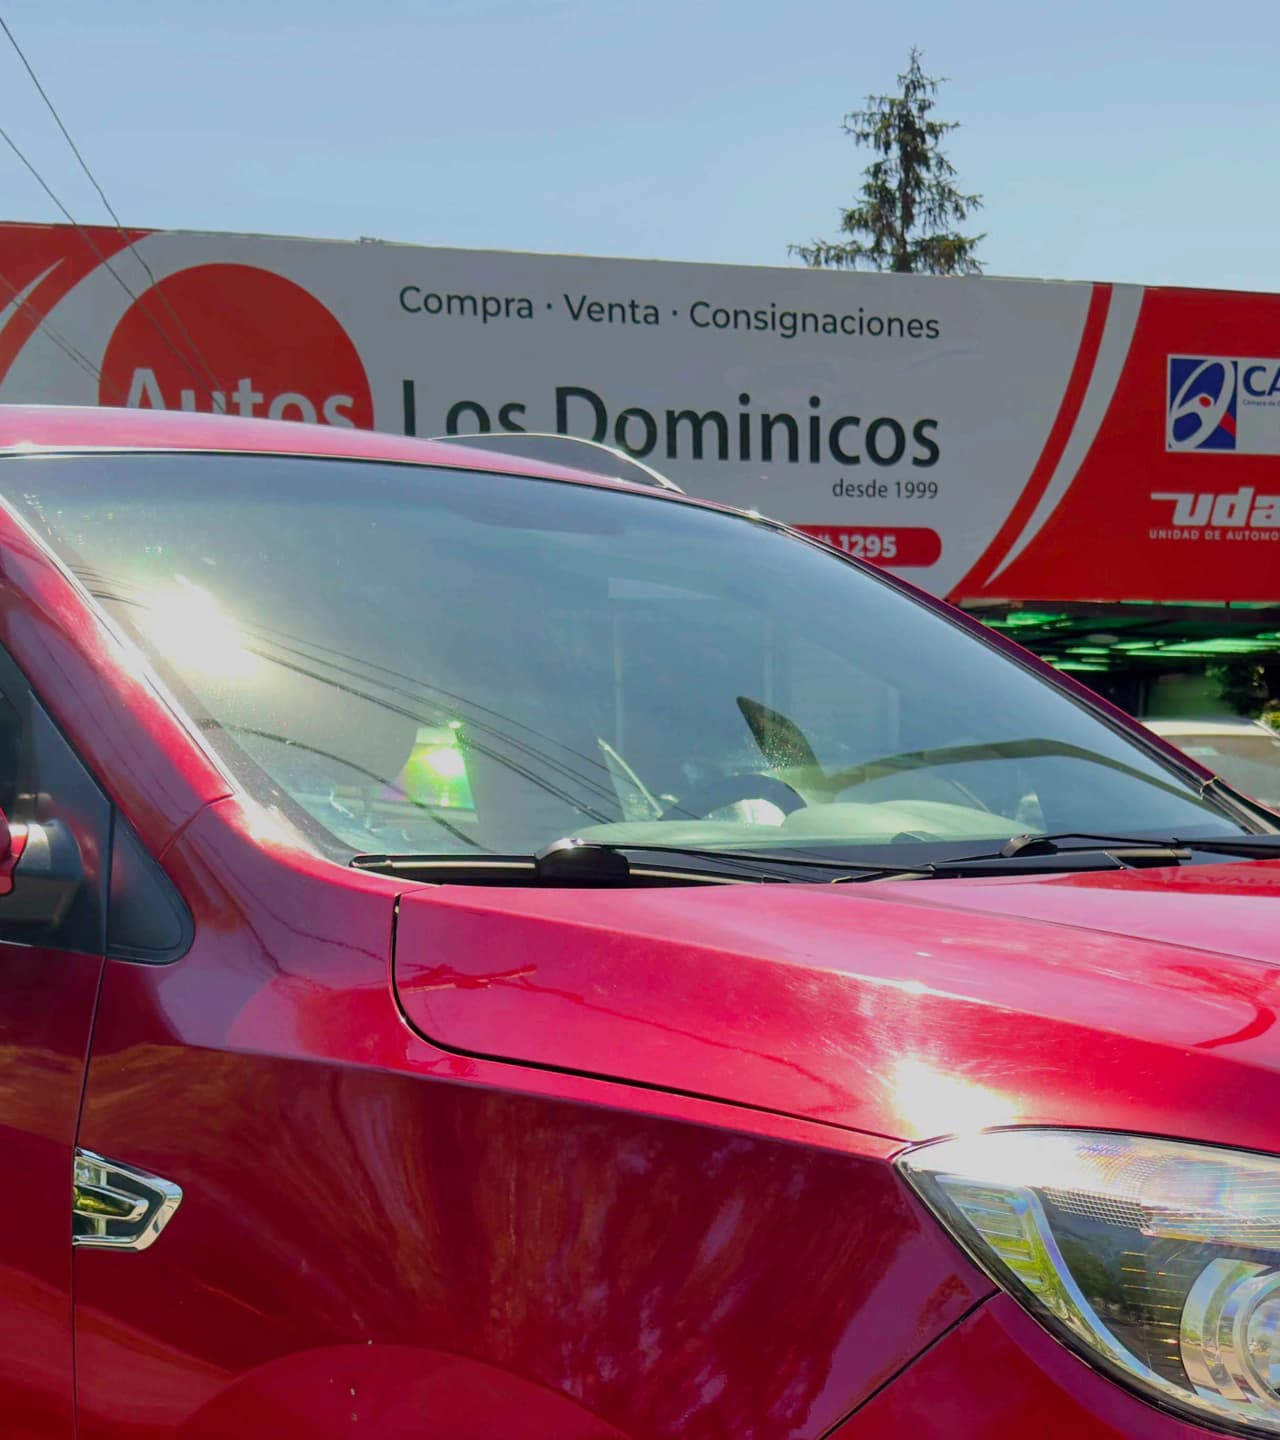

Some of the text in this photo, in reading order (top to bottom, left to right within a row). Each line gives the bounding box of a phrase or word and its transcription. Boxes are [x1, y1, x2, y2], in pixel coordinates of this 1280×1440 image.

[399, 286, 940, 340] Compra Venta Consignaciones
[554, 386, 940, 467] Dominicos
[831, 479, 939, 499] desde 1999
[839, 533, 898, 559] 1295
[1149, 528, 1200, 541] UNIDAD
[1204, 529, 1221, 541] DE
